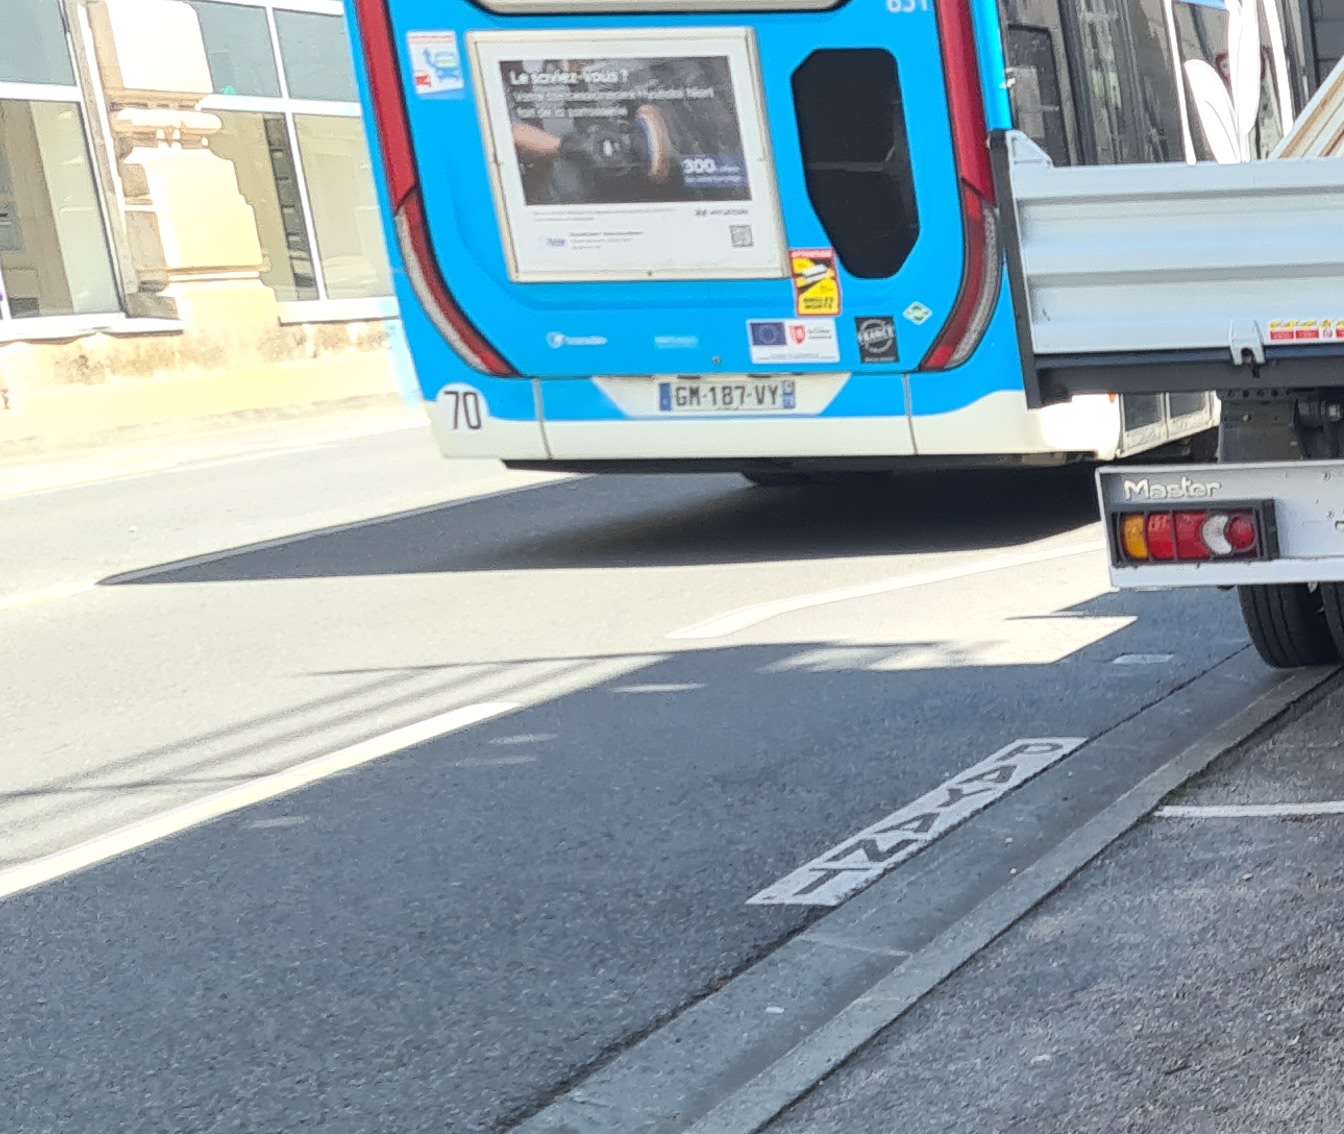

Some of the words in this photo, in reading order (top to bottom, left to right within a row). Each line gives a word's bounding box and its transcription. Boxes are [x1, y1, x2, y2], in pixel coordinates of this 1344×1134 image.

[510, 71, 528, 85] Le
[674, 384, 779, 407] GM-187-VY
[444, 391, 482, 430] 70
[1123, 476, 1221, 500] Master
[793, 742, 1064, 896] PAYANT
